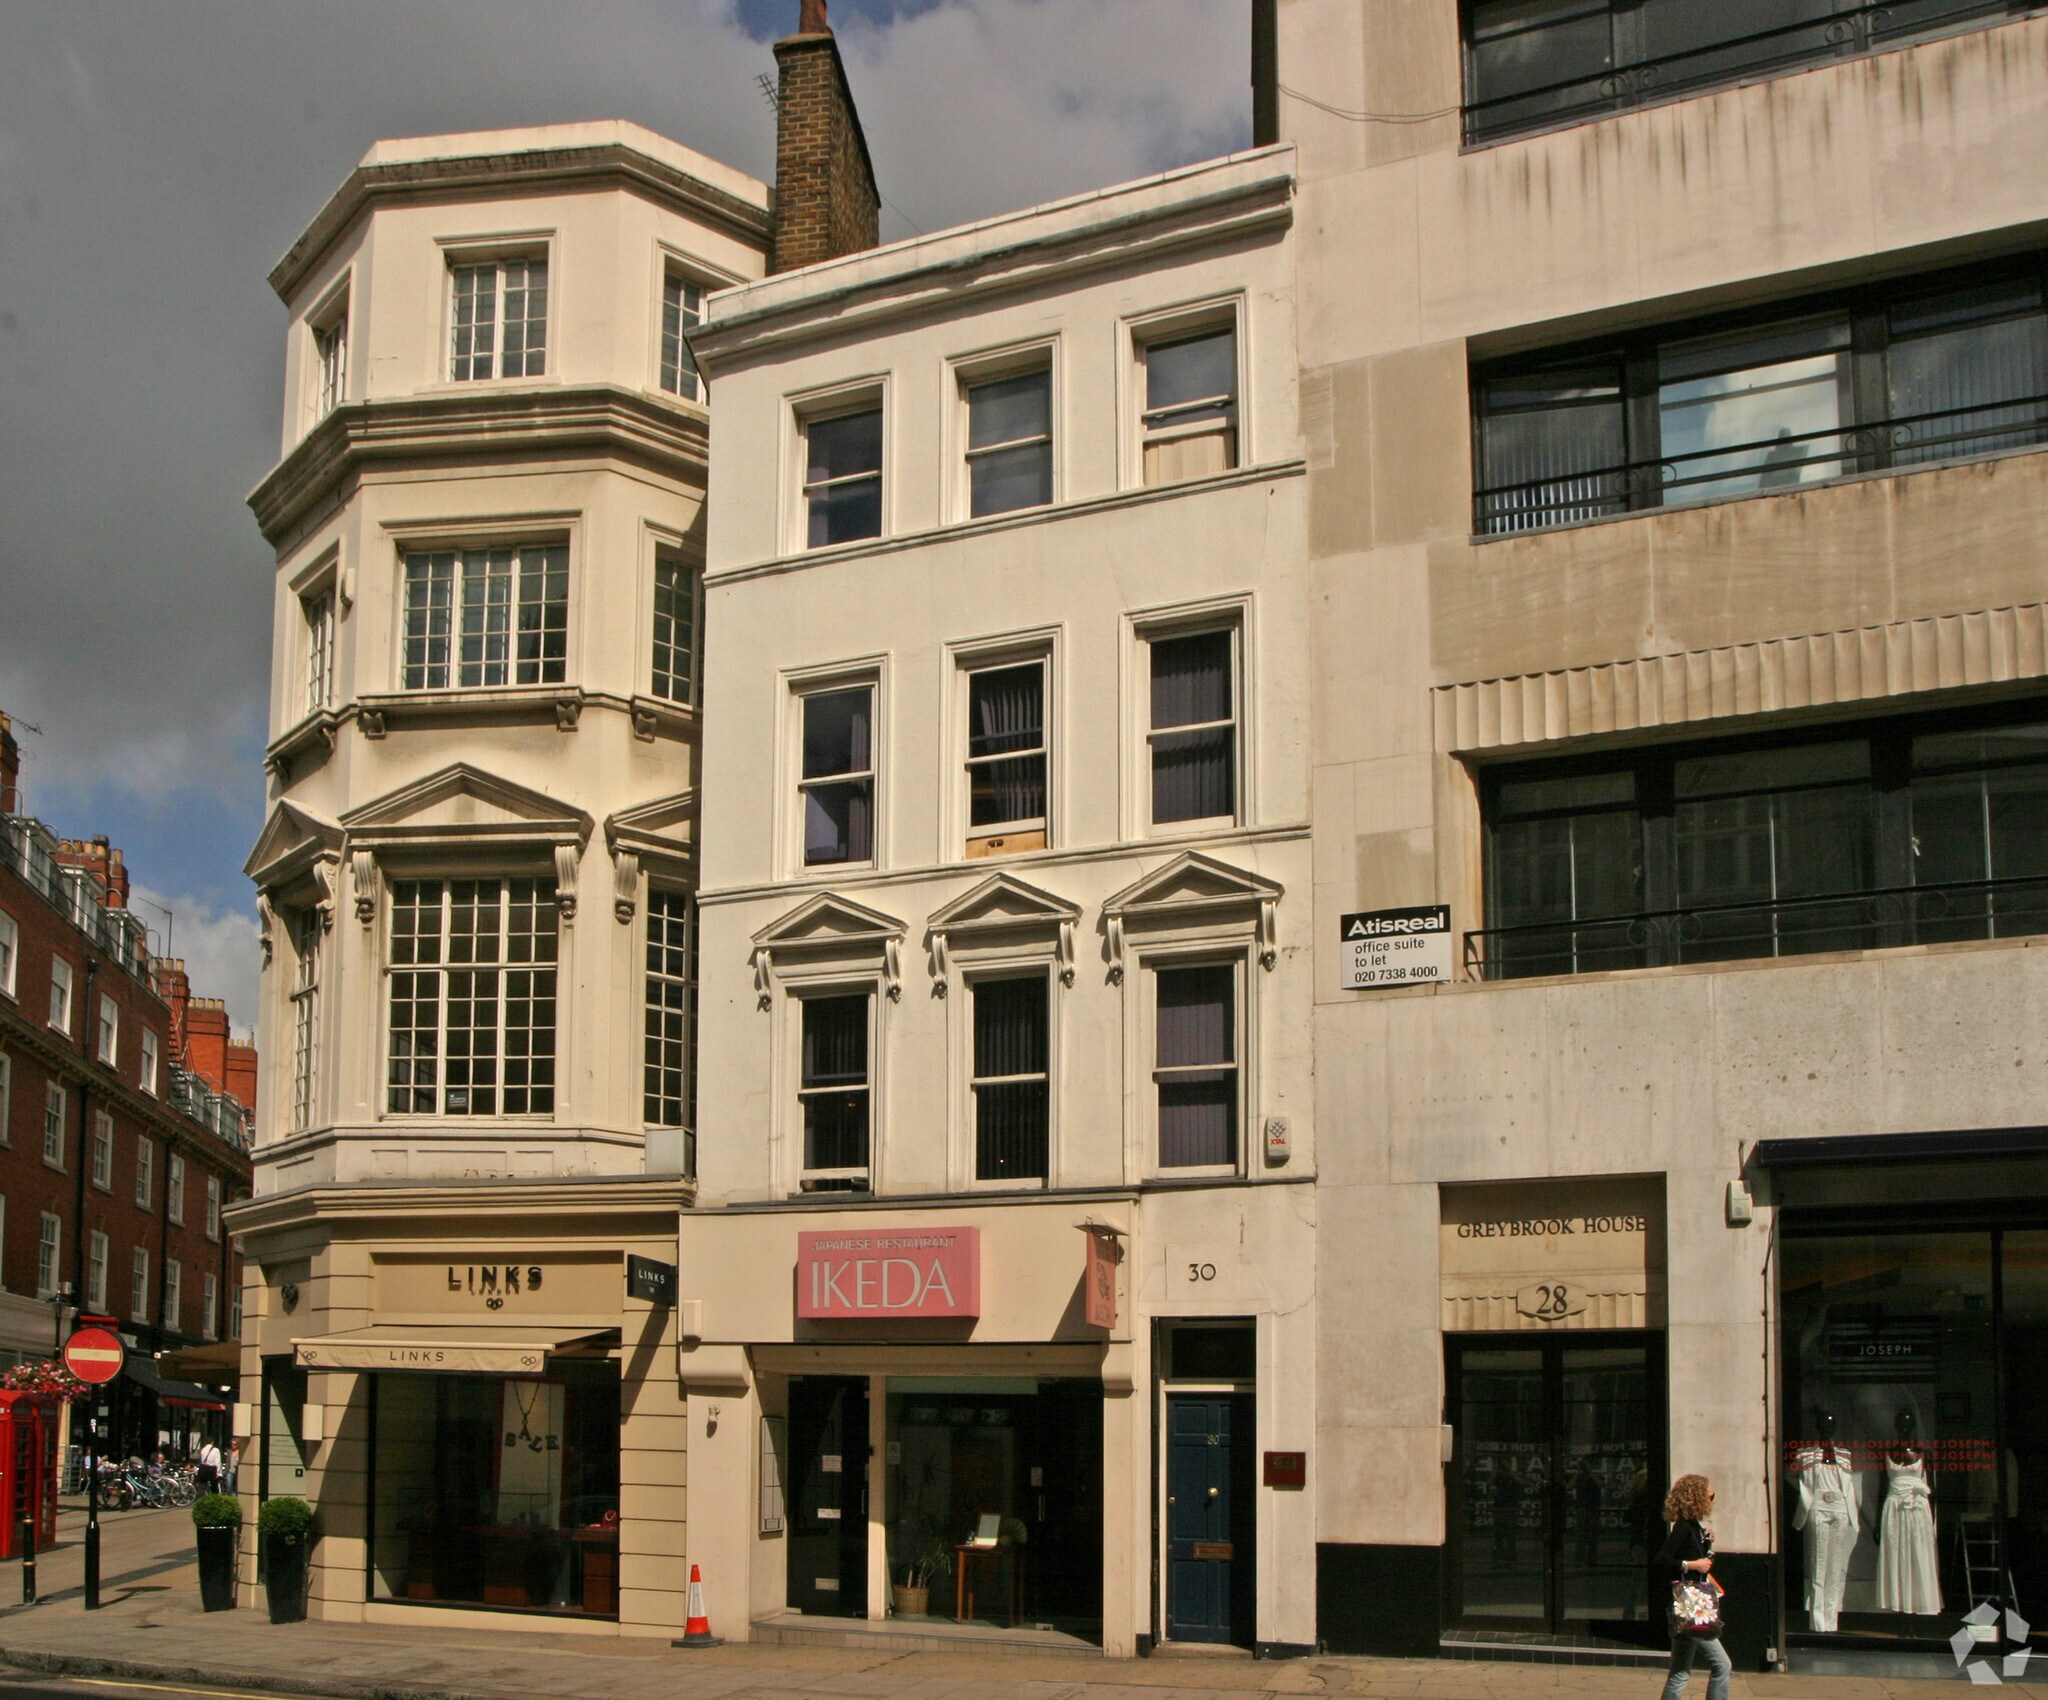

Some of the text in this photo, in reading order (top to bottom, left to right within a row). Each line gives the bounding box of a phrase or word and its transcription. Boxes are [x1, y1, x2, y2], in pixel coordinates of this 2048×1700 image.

[1354, 938, 1425, 955] office suite
[1354, 954, 1387, 968] to let
[1354, 965, 1438, 983] 020 7338 4000
[1457, 1216, 1647, 1238] GREYBROOK HOUSE
[812, 1236, 956, 1252] JAPANESE RESTAURANT
[448, 1266, 543, 1286] LINKS
[638, 1268, 666, 1284] LINKS
[1188, 1262, 1217, 1282] 30
[811, 1257, 957, 1309] IKEDA
[1535, 1285, 1568, 1315] 28
[389, 1350, 444, 1362] LINKS
[1859, 1344, 1912, 1356] JOSEPH
[504, 1425, 560, 1454] SALE
